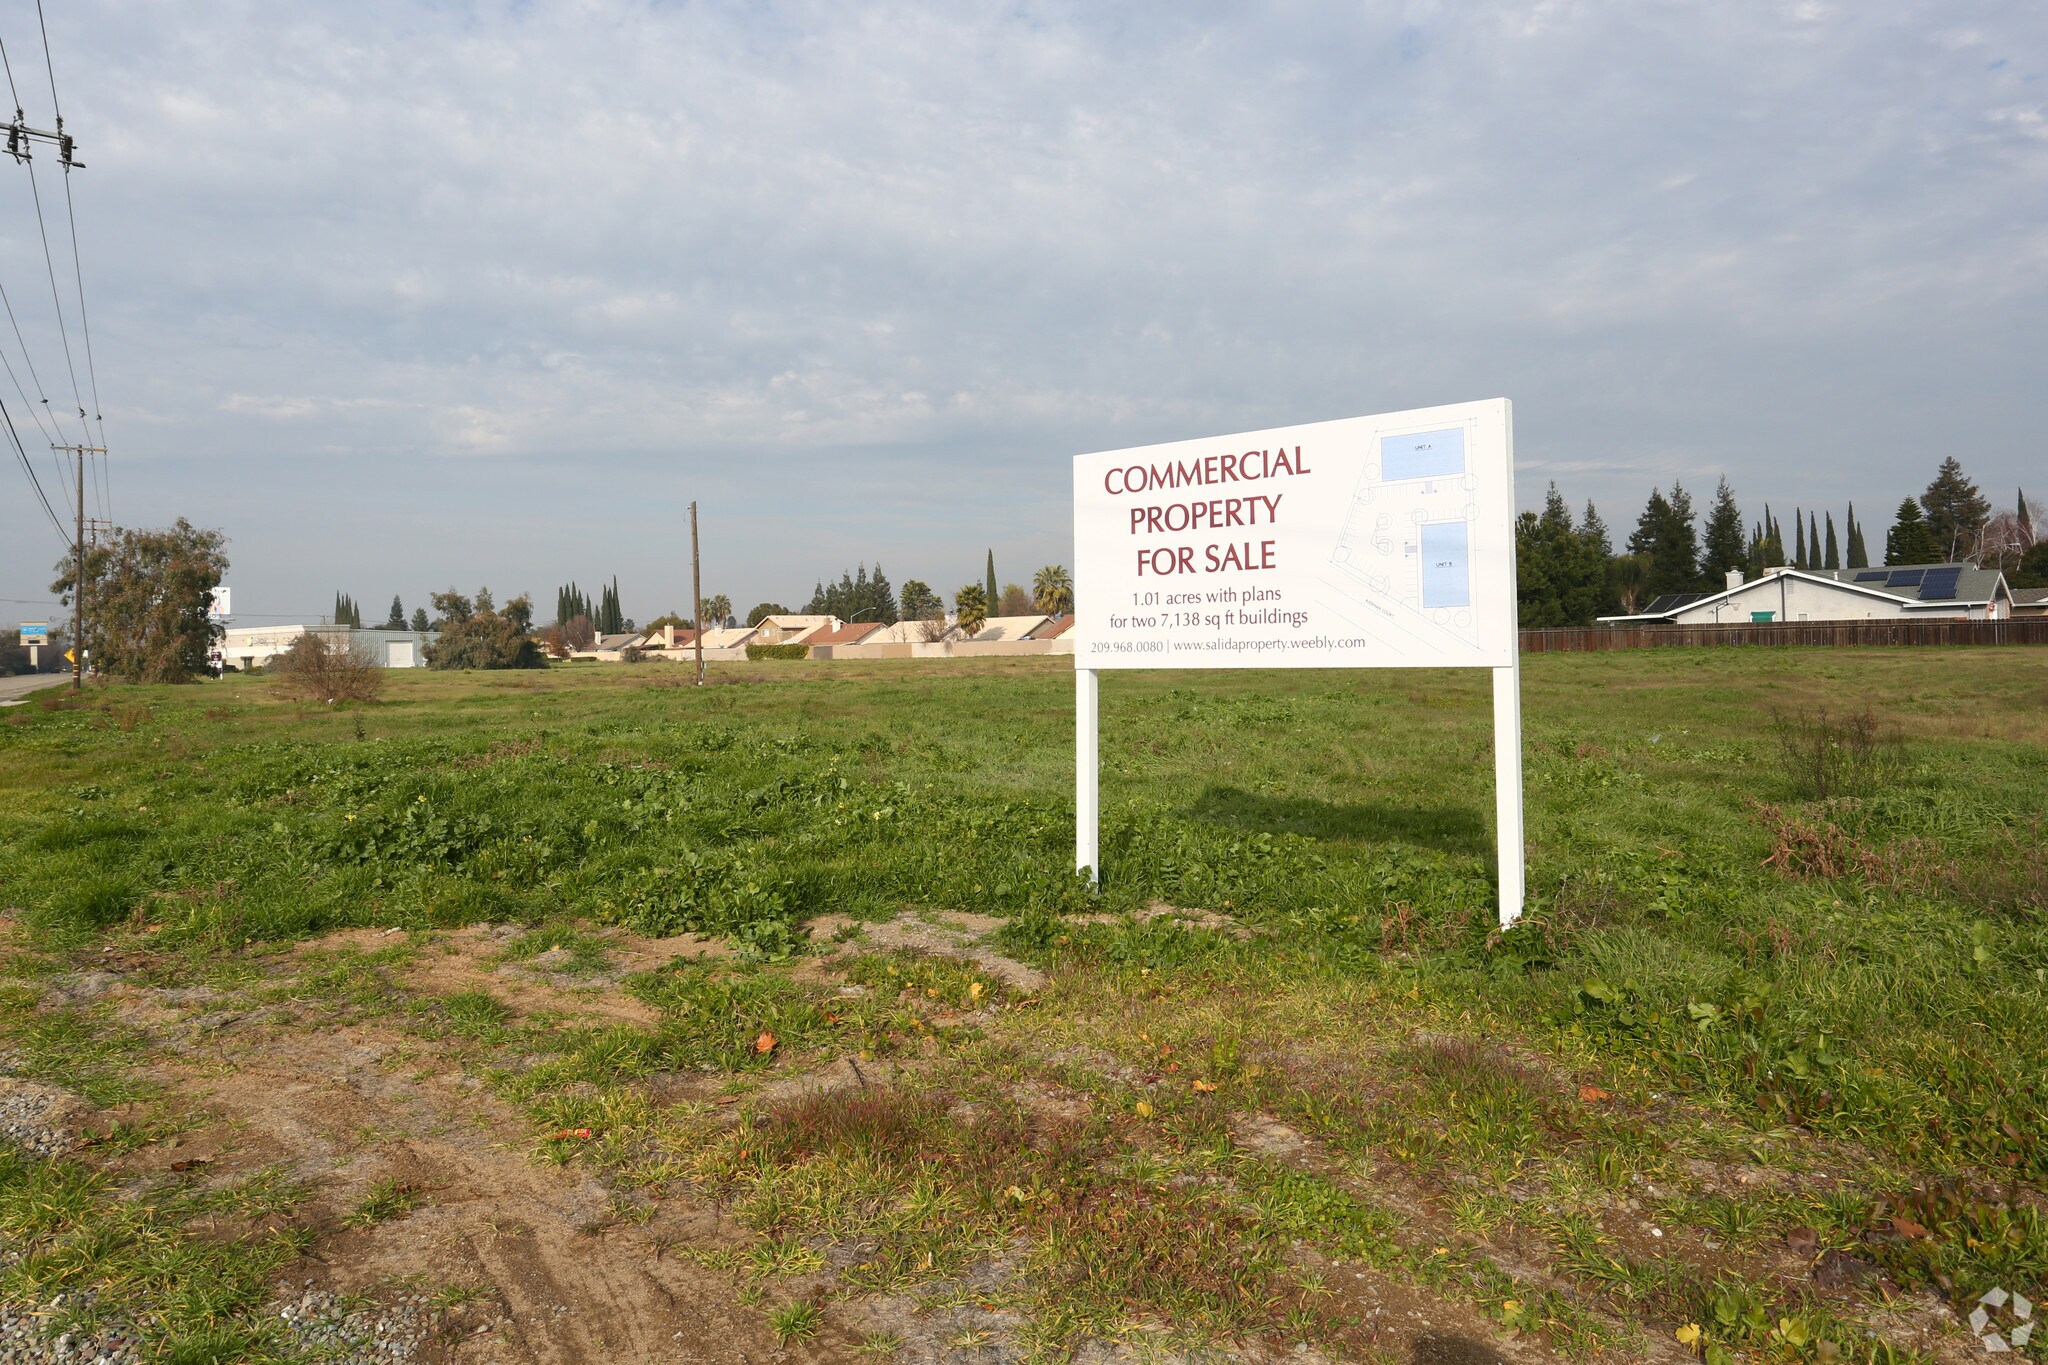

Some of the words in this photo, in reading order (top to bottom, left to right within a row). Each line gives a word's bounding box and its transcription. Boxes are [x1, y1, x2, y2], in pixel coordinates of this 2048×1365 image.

[1104, 445, 1311, 495] COMMERCIAL
[1130, 493, 1283, 535] PROPERTY
[1137, 547, 1197, 576] FOR
[1205, 540, 1276, 573] SALE
[1133, 592, 1160, 606] 1.01
[1166, 593, 1202, 605] acres
[1206, 587, 1237, 603] with
[1242, 586, 1282, 606] plans
[1110, 614, 1127, 628] for
[1132, 615, 1157, 628] two
[1161, 612, 1200, 629] 7,138
[1205, 615, 1220, 630] sq
[1225, 610, 1235, 626] ft
[1239, 608, 1309, 628] buildings
[1090, 641, 1164, 653] 209.968.0080
[1173, 636, 1366, 654] www.salidaproperty.weebly.com
